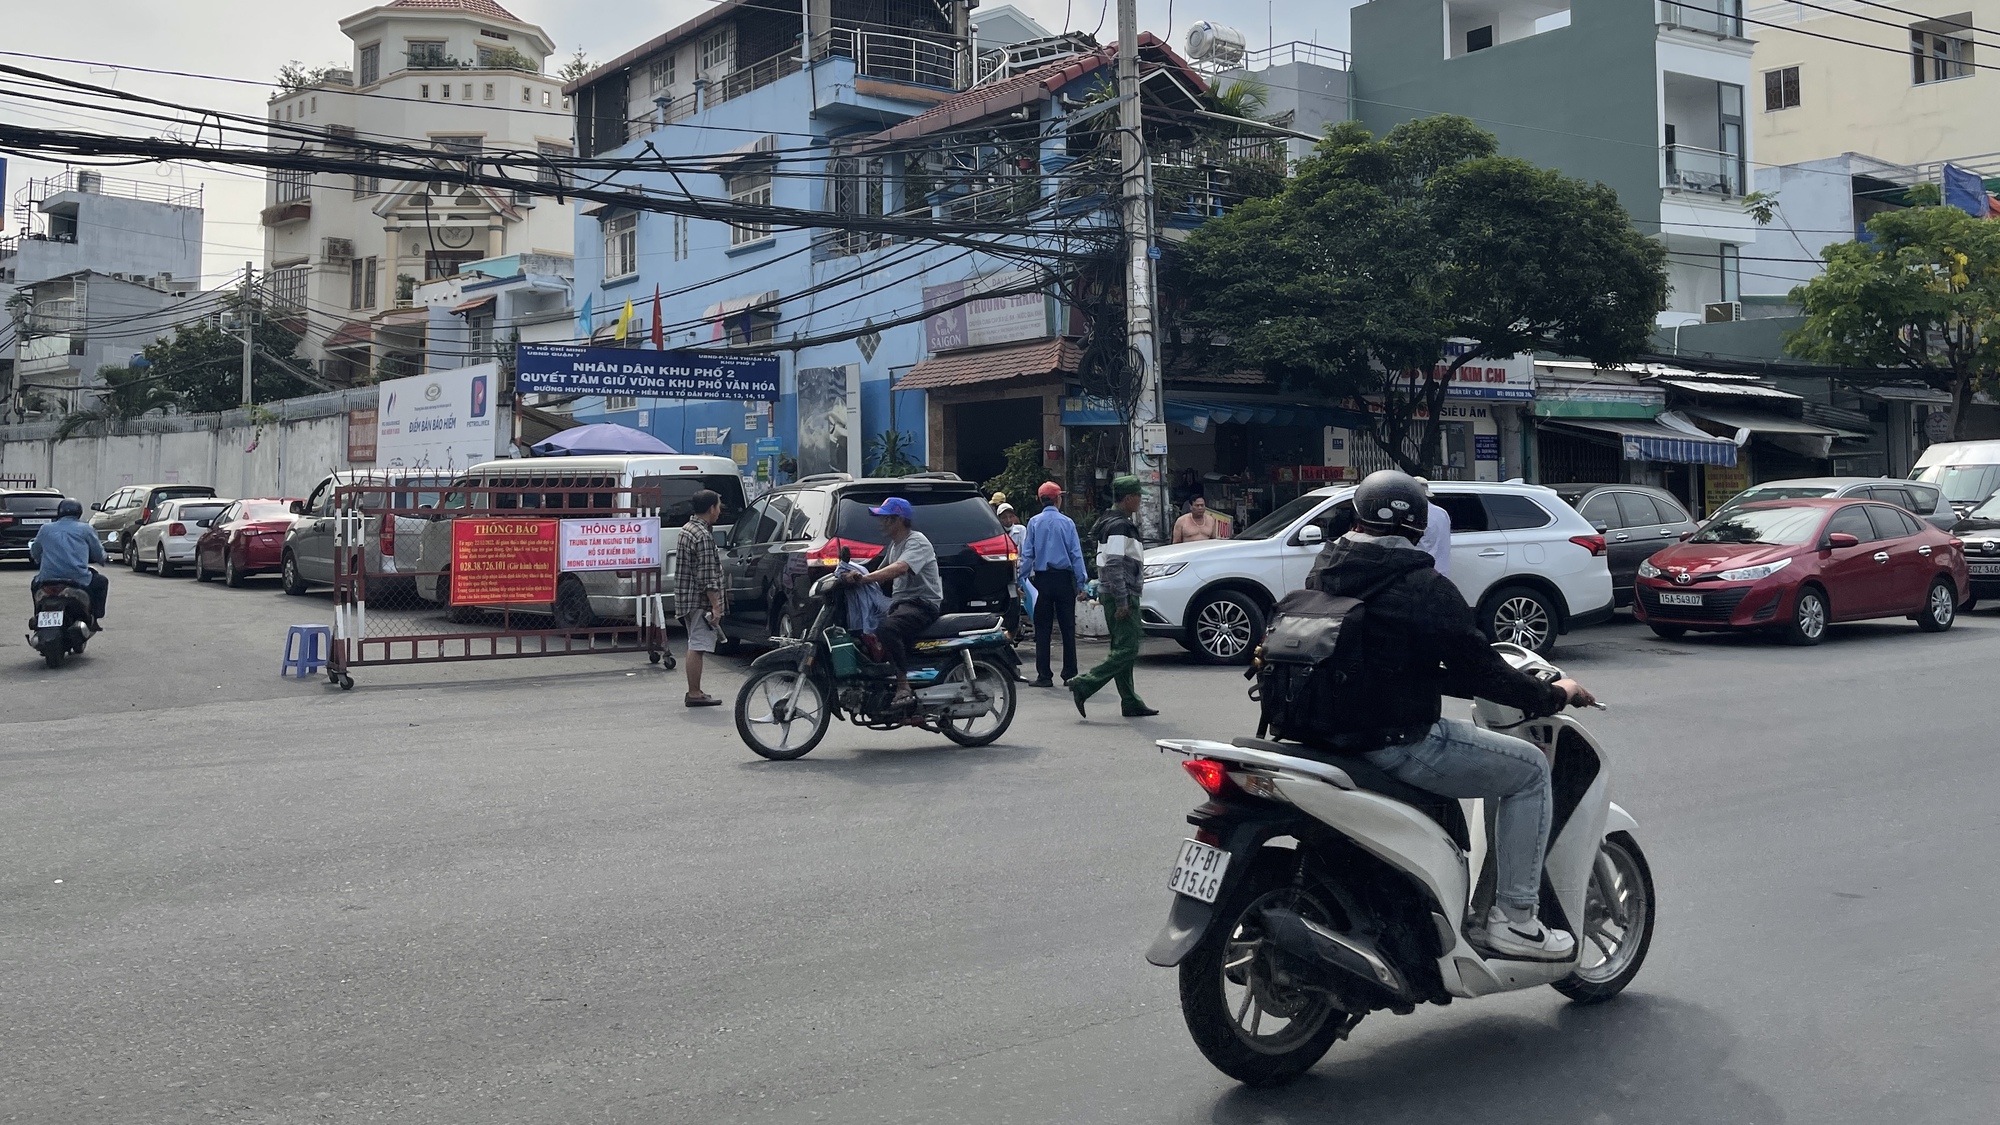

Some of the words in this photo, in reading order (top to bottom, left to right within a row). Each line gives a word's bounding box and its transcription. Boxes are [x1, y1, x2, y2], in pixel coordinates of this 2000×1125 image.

[932, 334, 960, 348] SAIGON
[573, 362, 618, 373] NHÂN
[622, 364, 654, 374] DÂN
[659, 366, 690, 376] KHU
[694, 366, 724, 377] PHỐ
[727, 370, 735, 378] 2
[1461, 366, 1482, 382] KIM
[1486, 368, 1506, 383] CHI
[520, 370, 567, 383] QUYẾT
[571, 374, 599, 384] TÂM
[602, 375, 627, 385] GIỮ
[630, 376, 665, 387] VỮNG
[669, 379, 694, 388] KHU
[698, 378, 723, 389] PHỐ
[725, 380, 749, 390] VĂN
[752, 381, 776, 391] HÓA
[1441, 404, 1466, 417] SIÊU
[1469, 404, 1486, 418] ÂM
[421, 417, 432, 431] BÁN
[443, 412, 457, 430] HIỂM
[474, 522, 513, 534] THÔNG
[516, 522, 538, 534] BÁO
[581, 523, 616, 534] THÔNG
[620, 522, 641, 533] BÁO
[624, 536, 635, 544] TIẾP
[460, 561, 506, 571] 028.38.726.101
[1172, 867, 1217, 899] 815.46
